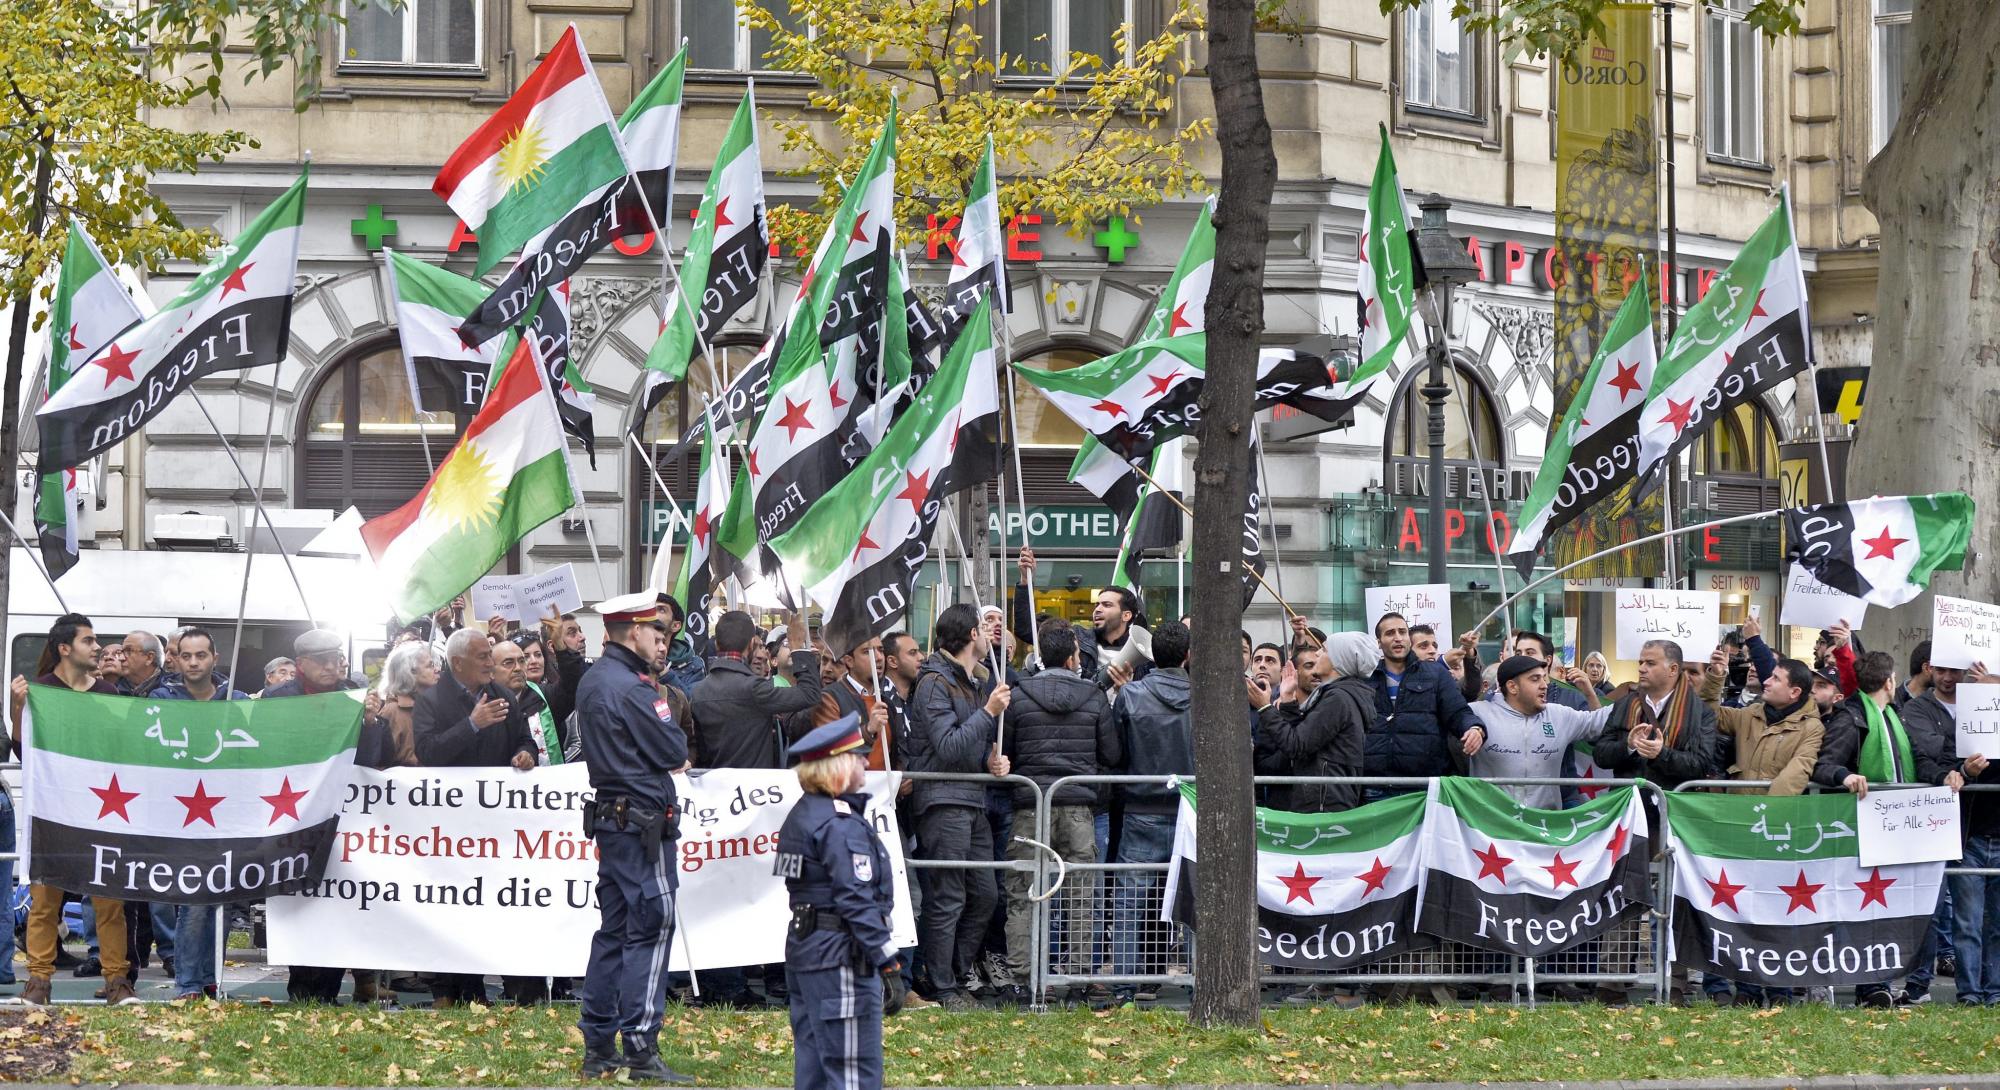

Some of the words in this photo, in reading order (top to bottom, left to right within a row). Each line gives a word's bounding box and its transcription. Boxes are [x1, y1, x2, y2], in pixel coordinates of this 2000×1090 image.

[524, 585, 536, 595] Die
[536, 575, 564, 591] Syrische
[1711, 575, 1742, 591] SEIT
[1738, 575, 1761, 591] 1870
[529, 588, 565, 606] Revolution
[1416, 592, 1436, 609] Putin
[1964, 633, 1991, 648] Macht
[144, 705, 260, 764] حرية
[408, 779, 464, 808] die
[729, 784, 784, 816] des
[1908, 794, 1922, 808] ist
[1924, 792, 1957, 806] Heimat
[1750, 802, 1856, 855] حرية
[1903, 815, 1923, 830] Alle
[88, 843, 310, 894] Freedom
[414, 877, 484, 907] und
[496, 877, 552, 907] die
[1708, 927, 1904, 977] Freedom
